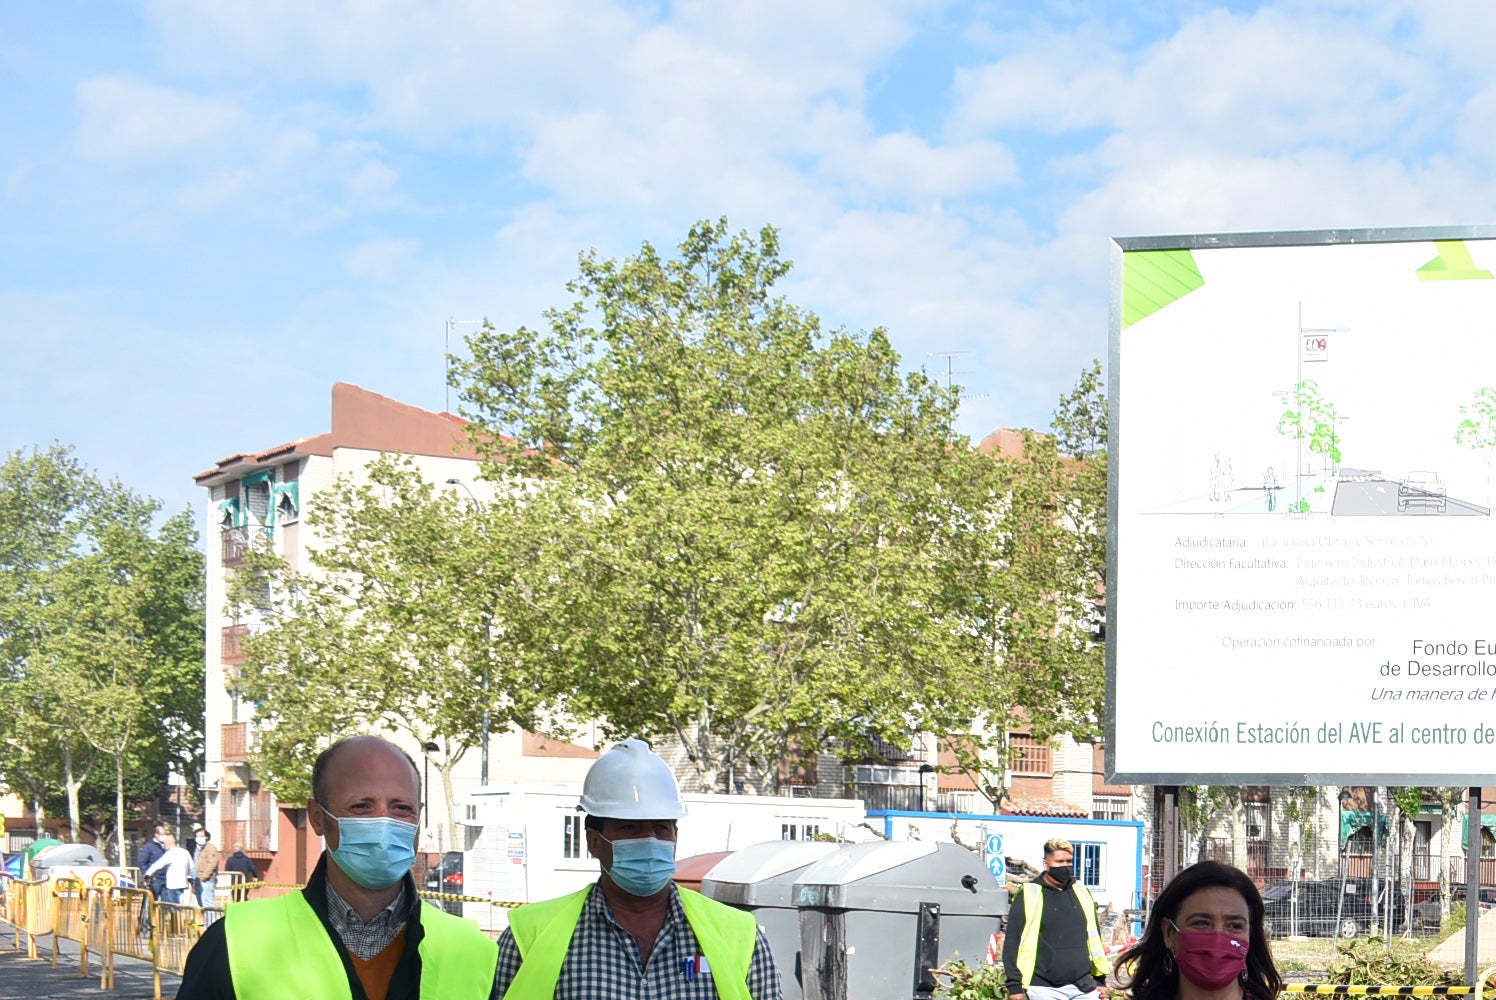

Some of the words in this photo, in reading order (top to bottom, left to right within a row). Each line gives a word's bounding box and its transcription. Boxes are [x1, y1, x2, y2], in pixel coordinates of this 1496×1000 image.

[1174, 536, 1249, 550] Adjudicataria:
[1174, 557, 1226, 569] Dirección
[1229, 557, 1289, 569] Facultativa:
[1175, 599, 1220, 613] Importe
[1222, 599, 1297, 614] Adjudicación:
[1410, 596, 1431, 609] IVA
[1222, 636, 1280, 650] Operación
[1283, 635, 1353, 649] cofinanciada
[1356, 638, 1377, 650] por
[1413, 639, 1468, 656] Fondo
[1379, 660, 1401, 677] de
[1407, 660, 1496, 677] Desarrollo
[1371, 687, 1403, 701] Una
[1405, 690, 1464, 701] manera
[1467, 687, 1488, 701] de
[1151, 720, 1230, 744] Conexión
[1236, 720, 1310, 744] Estación
[1317, 721, 1343, 744] del
[1348, 721, 1383, 744] AVE
[1388, 721, 1404, 744] al
[1411, 723, 1467, 745] centro
